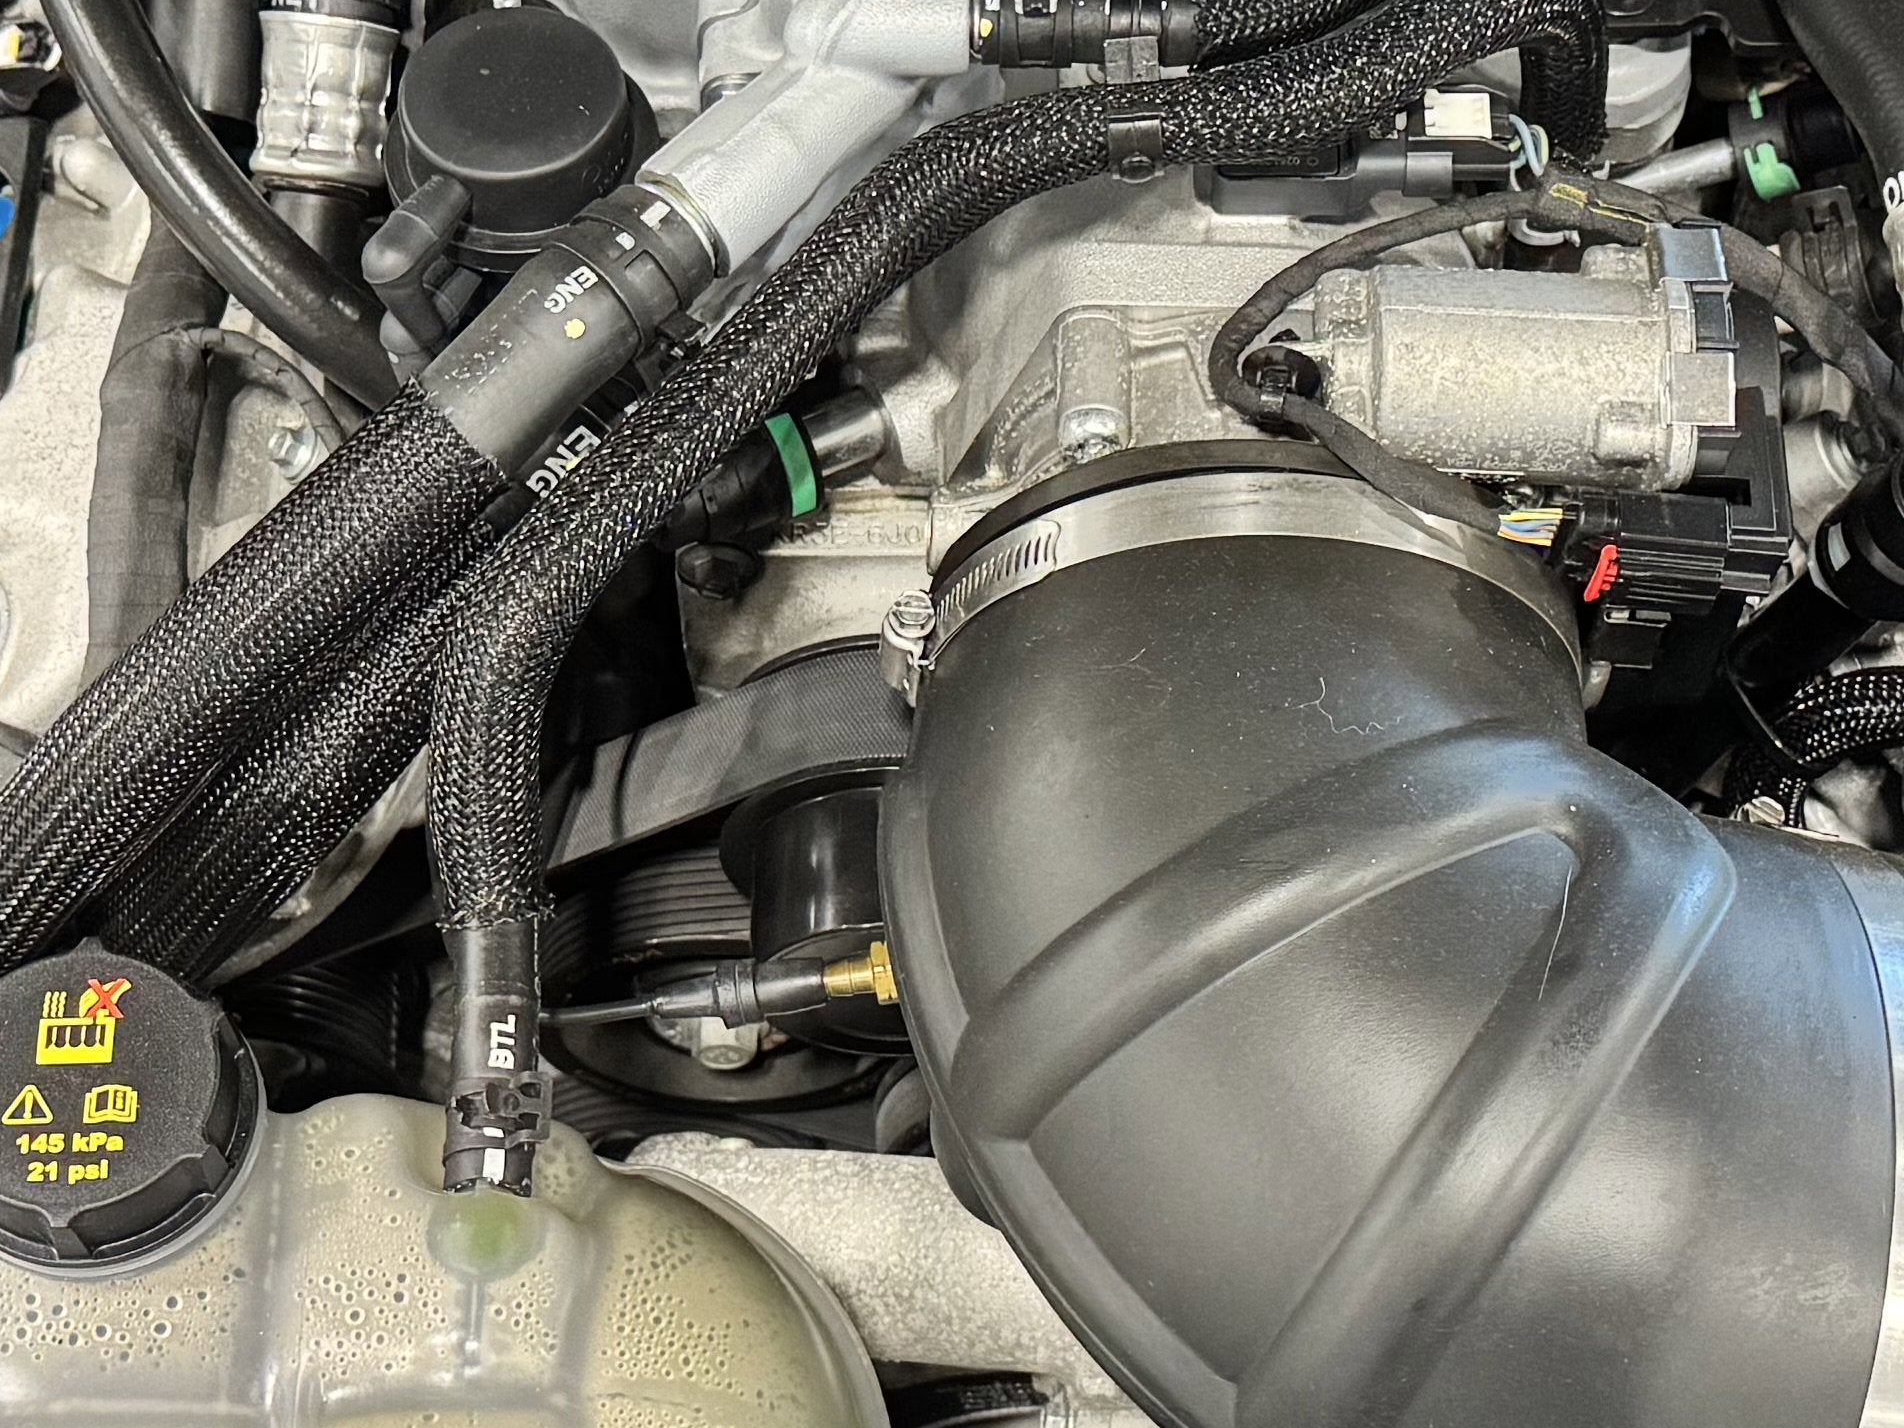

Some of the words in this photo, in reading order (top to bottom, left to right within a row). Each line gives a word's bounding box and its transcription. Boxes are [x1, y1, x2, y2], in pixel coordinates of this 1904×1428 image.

[543, 265, 599, 314] ENG
[525, 424, 602, 499] ENG
[487, 1014, 517, 1070] BTL
[15, 1133, 66, 1155] 145
[71, 1132, 124, 1153] kPa
[26, 1161, 59, 1183] 21
[67, 1159, 109, 1185] psi
